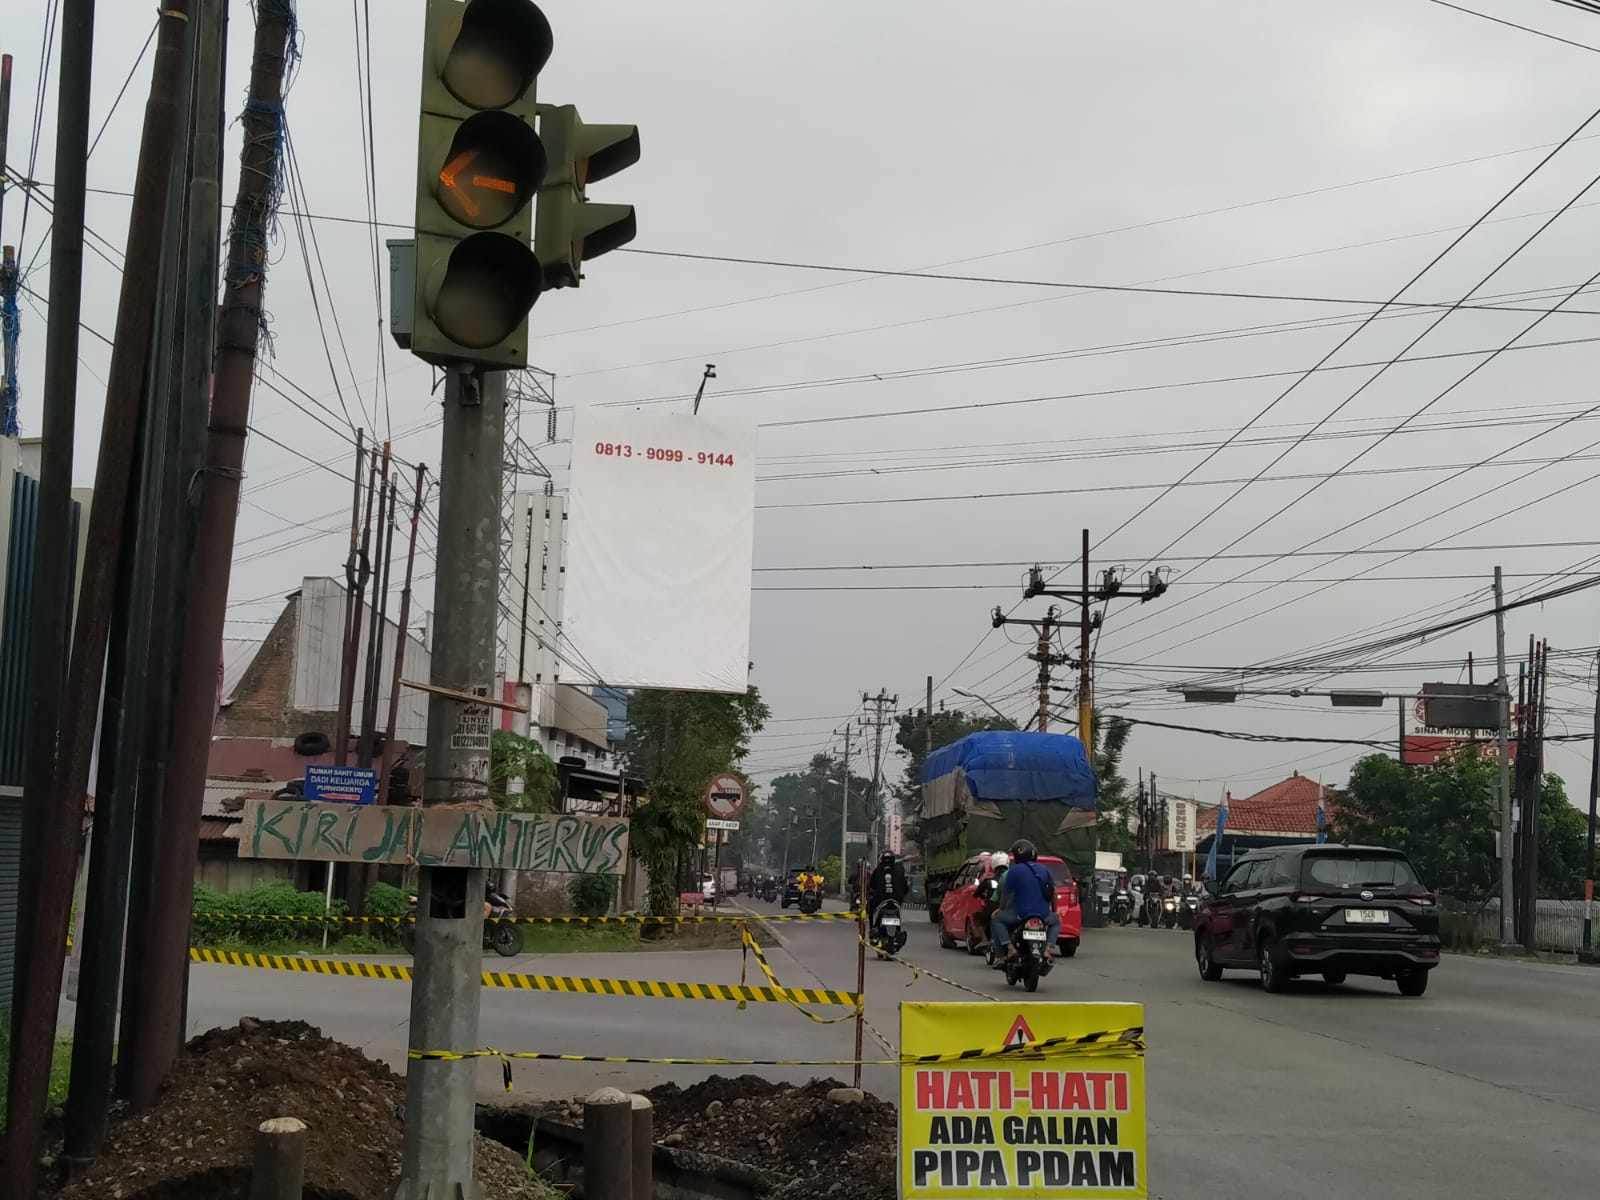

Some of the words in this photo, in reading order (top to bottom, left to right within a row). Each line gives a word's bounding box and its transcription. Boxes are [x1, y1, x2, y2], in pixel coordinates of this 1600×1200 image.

[595, 442, 632, 457] 0813
[646, 447, 683, 462] 9099
[697, 452, 734, 467] 9144
[1414, 727, 1443, 735] SINAR
[309, 767, 333, 775] RUMAH
[333, 769, 353, 777] SAKIT
[354, 770, 374, 778] UMUM
[310, 775, 329, 784] DADI
[330, 777, 370, 787] KELUARGA
[316, 784, 363, 794] PURWOKERTO
[1175, 802, 1186, 848] BENGKEL
[916, 1071, 1128, 1111] HATI-HATI
[929, 1115, 995, 1145] ADA
[1003, 1115, 1118, 1146] GALIAN
[914, 1150, 1008, 1187] PIPA
[1016, 1150, 1136, 1187] PDAM
